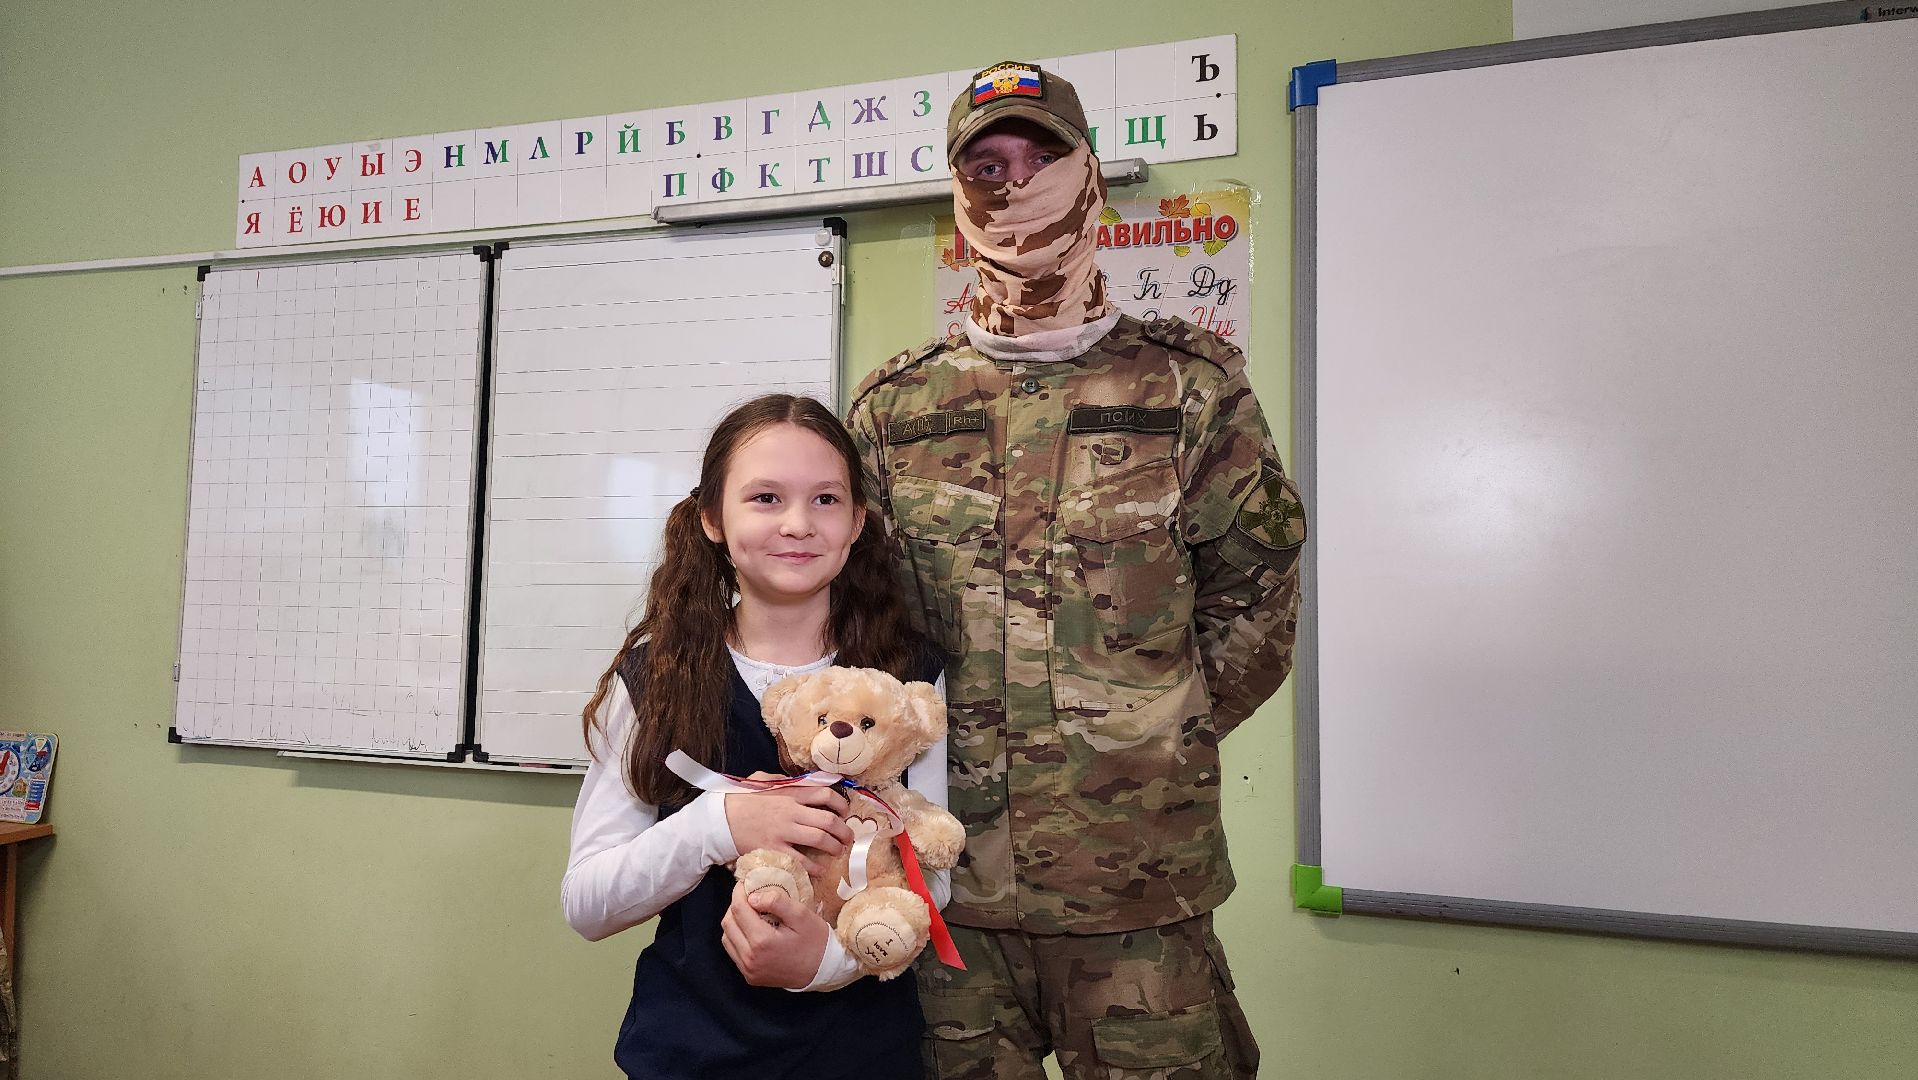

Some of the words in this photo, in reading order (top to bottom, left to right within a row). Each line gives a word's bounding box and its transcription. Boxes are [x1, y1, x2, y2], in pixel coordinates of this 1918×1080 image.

[243, 211, 262, 235] Я
[287, 206, 304, 234] Ё
[317, 204, 346, 229] Ю
[361, 201, 383, 225] И
[403, 198, 421, 222] Е
[662, 172, 687, 198] П
[711, 167, 735, 194] Ф
[758, 162, 783, 189] К
[808, 156, 831, 184] Т
[852, 150, 889, 179] Ш
[910, 145, 935, 173] С
[1124, 114, 1167, 149] Щ
[1193, 113, 1219, 142] Ь
[248, 166, 266, 188] А
[288, 161, 307, 184] О
[324, 156, 342, 181] У
[360, 153, 385, 177] Ы
[404, 149, 422, 173] Э
[444, 144, 465, 168] Н
[483, 139, 510, 165] М
[529, 136, 550, 160] Л
[575, 131, 594, 155] Р
[617, 122, 642, 154] Й
[665, 120, 686, 146] Б
[713, 115, 733, 141] В
[761, 109, 780, 135] Г
[808, 100, 832, 133] Д
[851, 95, 889, 125] Ж
[912, 90, 932, 118] З
[1191, 53, 1220, 83] Ъ
